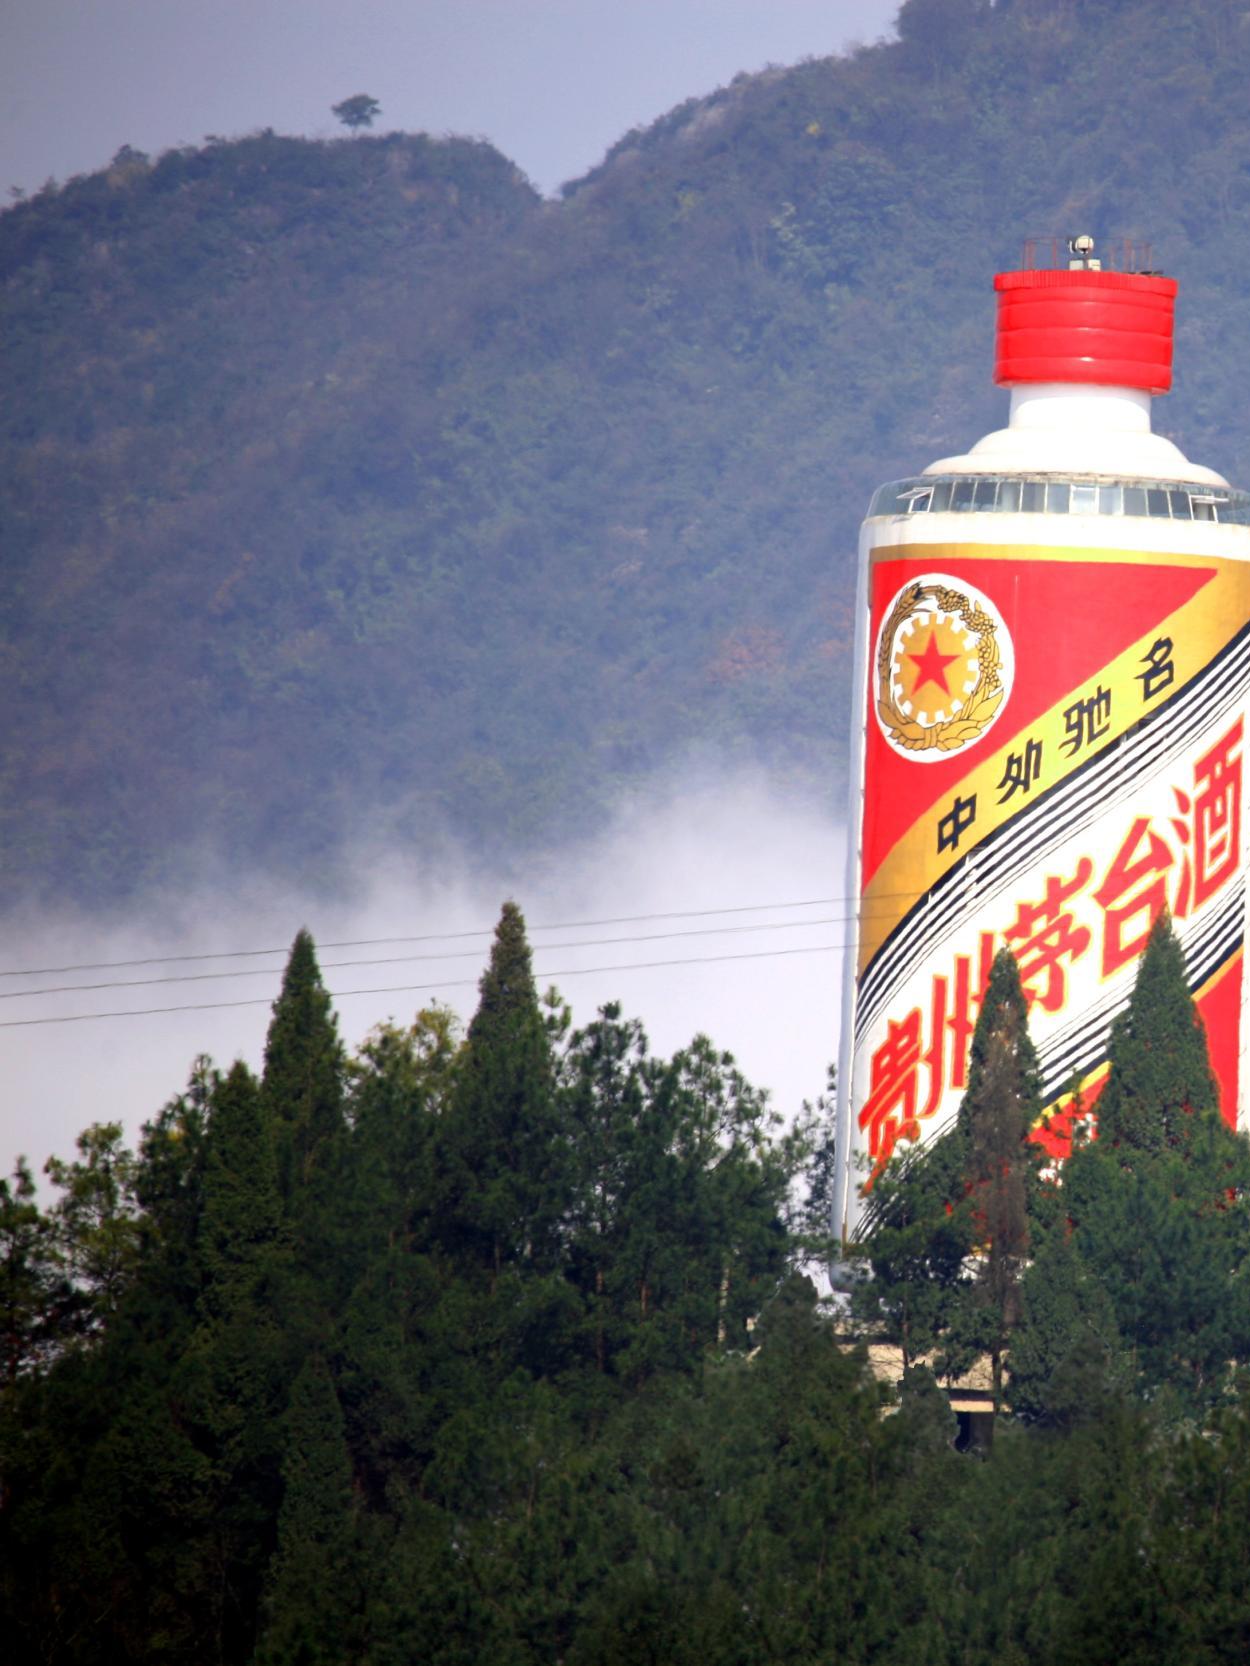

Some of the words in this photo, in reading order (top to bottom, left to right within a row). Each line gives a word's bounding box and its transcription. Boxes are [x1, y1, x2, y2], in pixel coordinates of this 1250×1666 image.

[936, 636, 1175, 855] 中外驰名
[858, 712, 1245, 1198] 贵州茅台酒
